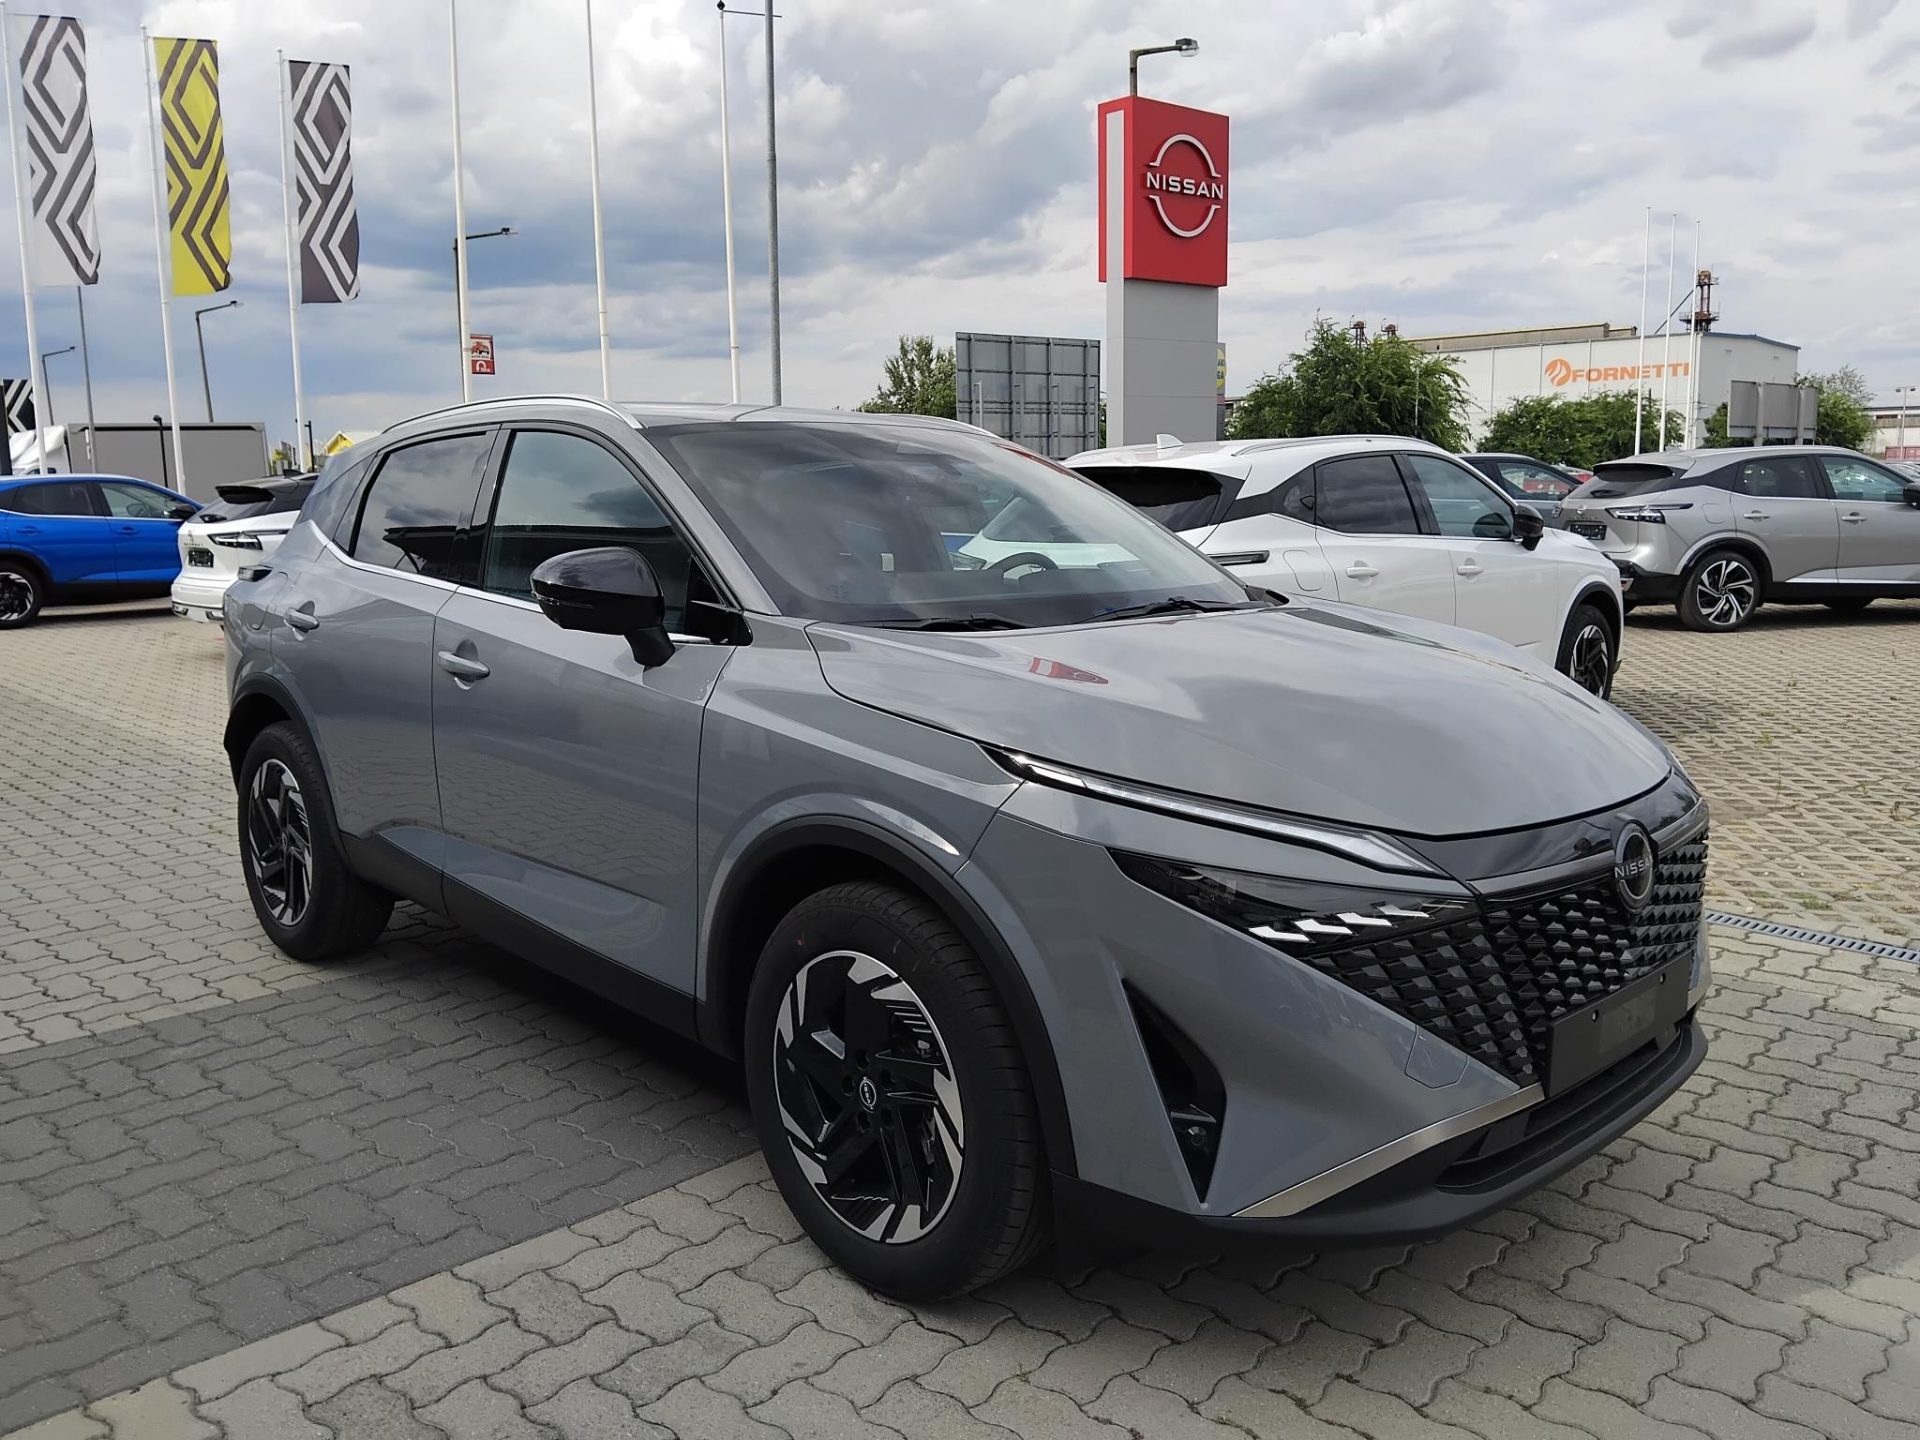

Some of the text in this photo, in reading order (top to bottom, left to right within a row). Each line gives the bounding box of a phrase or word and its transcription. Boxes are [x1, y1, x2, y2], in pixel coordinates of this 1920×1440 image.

[1146, 172, 1224, 200] NISSAN
[1572, 362, 1690, 383] FORNETTI
[1614, 856, 1653, 878] NISSA
